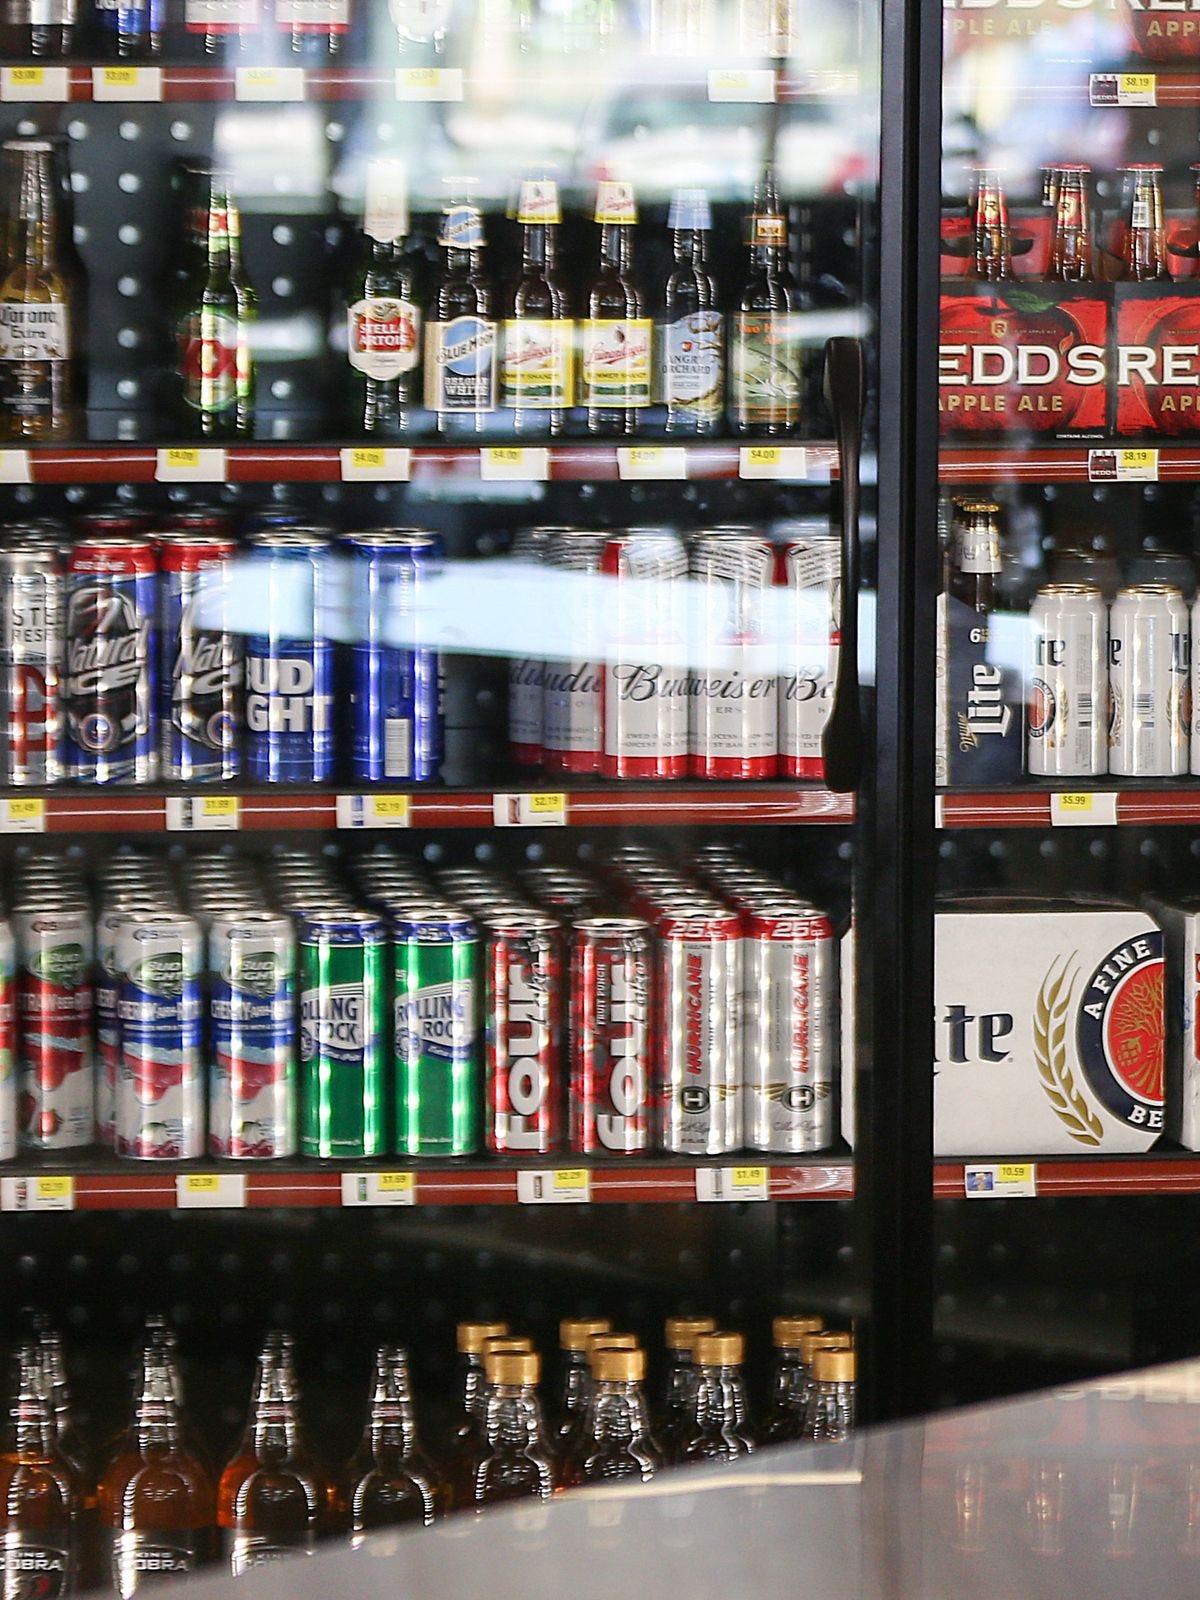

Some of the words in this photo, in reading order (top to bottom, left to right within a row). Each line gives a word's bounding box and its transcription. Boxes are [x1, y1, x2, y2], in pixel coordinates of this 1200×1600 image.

[1126, 78, 1150, 87] $8.19
[360, 324, 407, 334] STELLA
[359, 335, 408, 345] ARTOIS
[437, 345, 466, 363] BLUE
[939, 331, 1106, 386] EDD'S
[662, 364, 711, 375] ORCHARD
[445, 386, 487, 395] WHITE
[1018, 396, 1063, 411] ALE
[1124, 453, 1147, 461] $8.19
[970, 628, 980, 643] 6
[968, 664, 1011, 737] Lite
[246, 696, 335, 732] GHT
[1062, 796, 1086, 806] $5.99
[668, 922, 704, 937] 25
[772, 921, 808, 937] 25
[1093, 939, 1151, 995] FINE
[596, 1001, 607, 1026] FRUIT
[687, 952, 703, 1076] HURRICANE
[792, 952, 809, 1074] HURRICANE
[1083, 1002, 1104, 1020] A
[496, 964, 549, 1151] FOUR
[1002, 1167, 1025, 1177] 10.59
